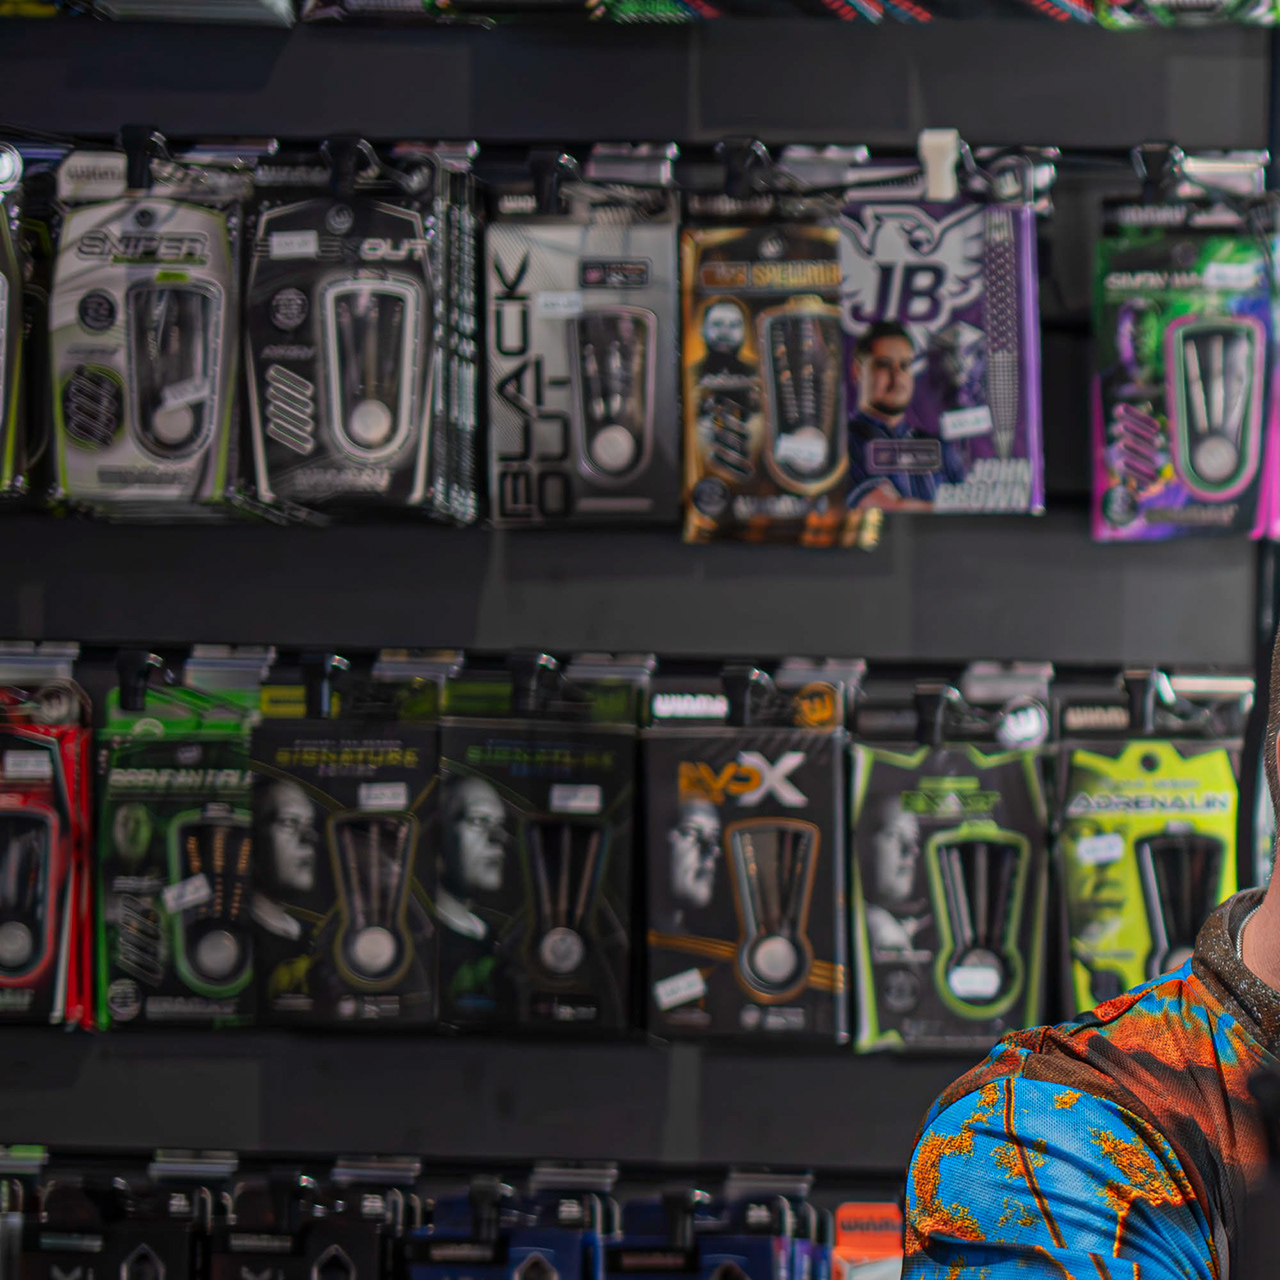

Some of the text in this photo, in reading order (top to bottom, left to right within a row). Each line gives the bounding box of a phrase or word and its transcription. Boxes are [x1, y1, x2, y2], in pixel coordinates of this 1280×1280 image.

[77, 230, 211, 261] SNIPER
[852, 261, 947, 322] JB
[1066, 790, 1231, 815] ADRENALIN
